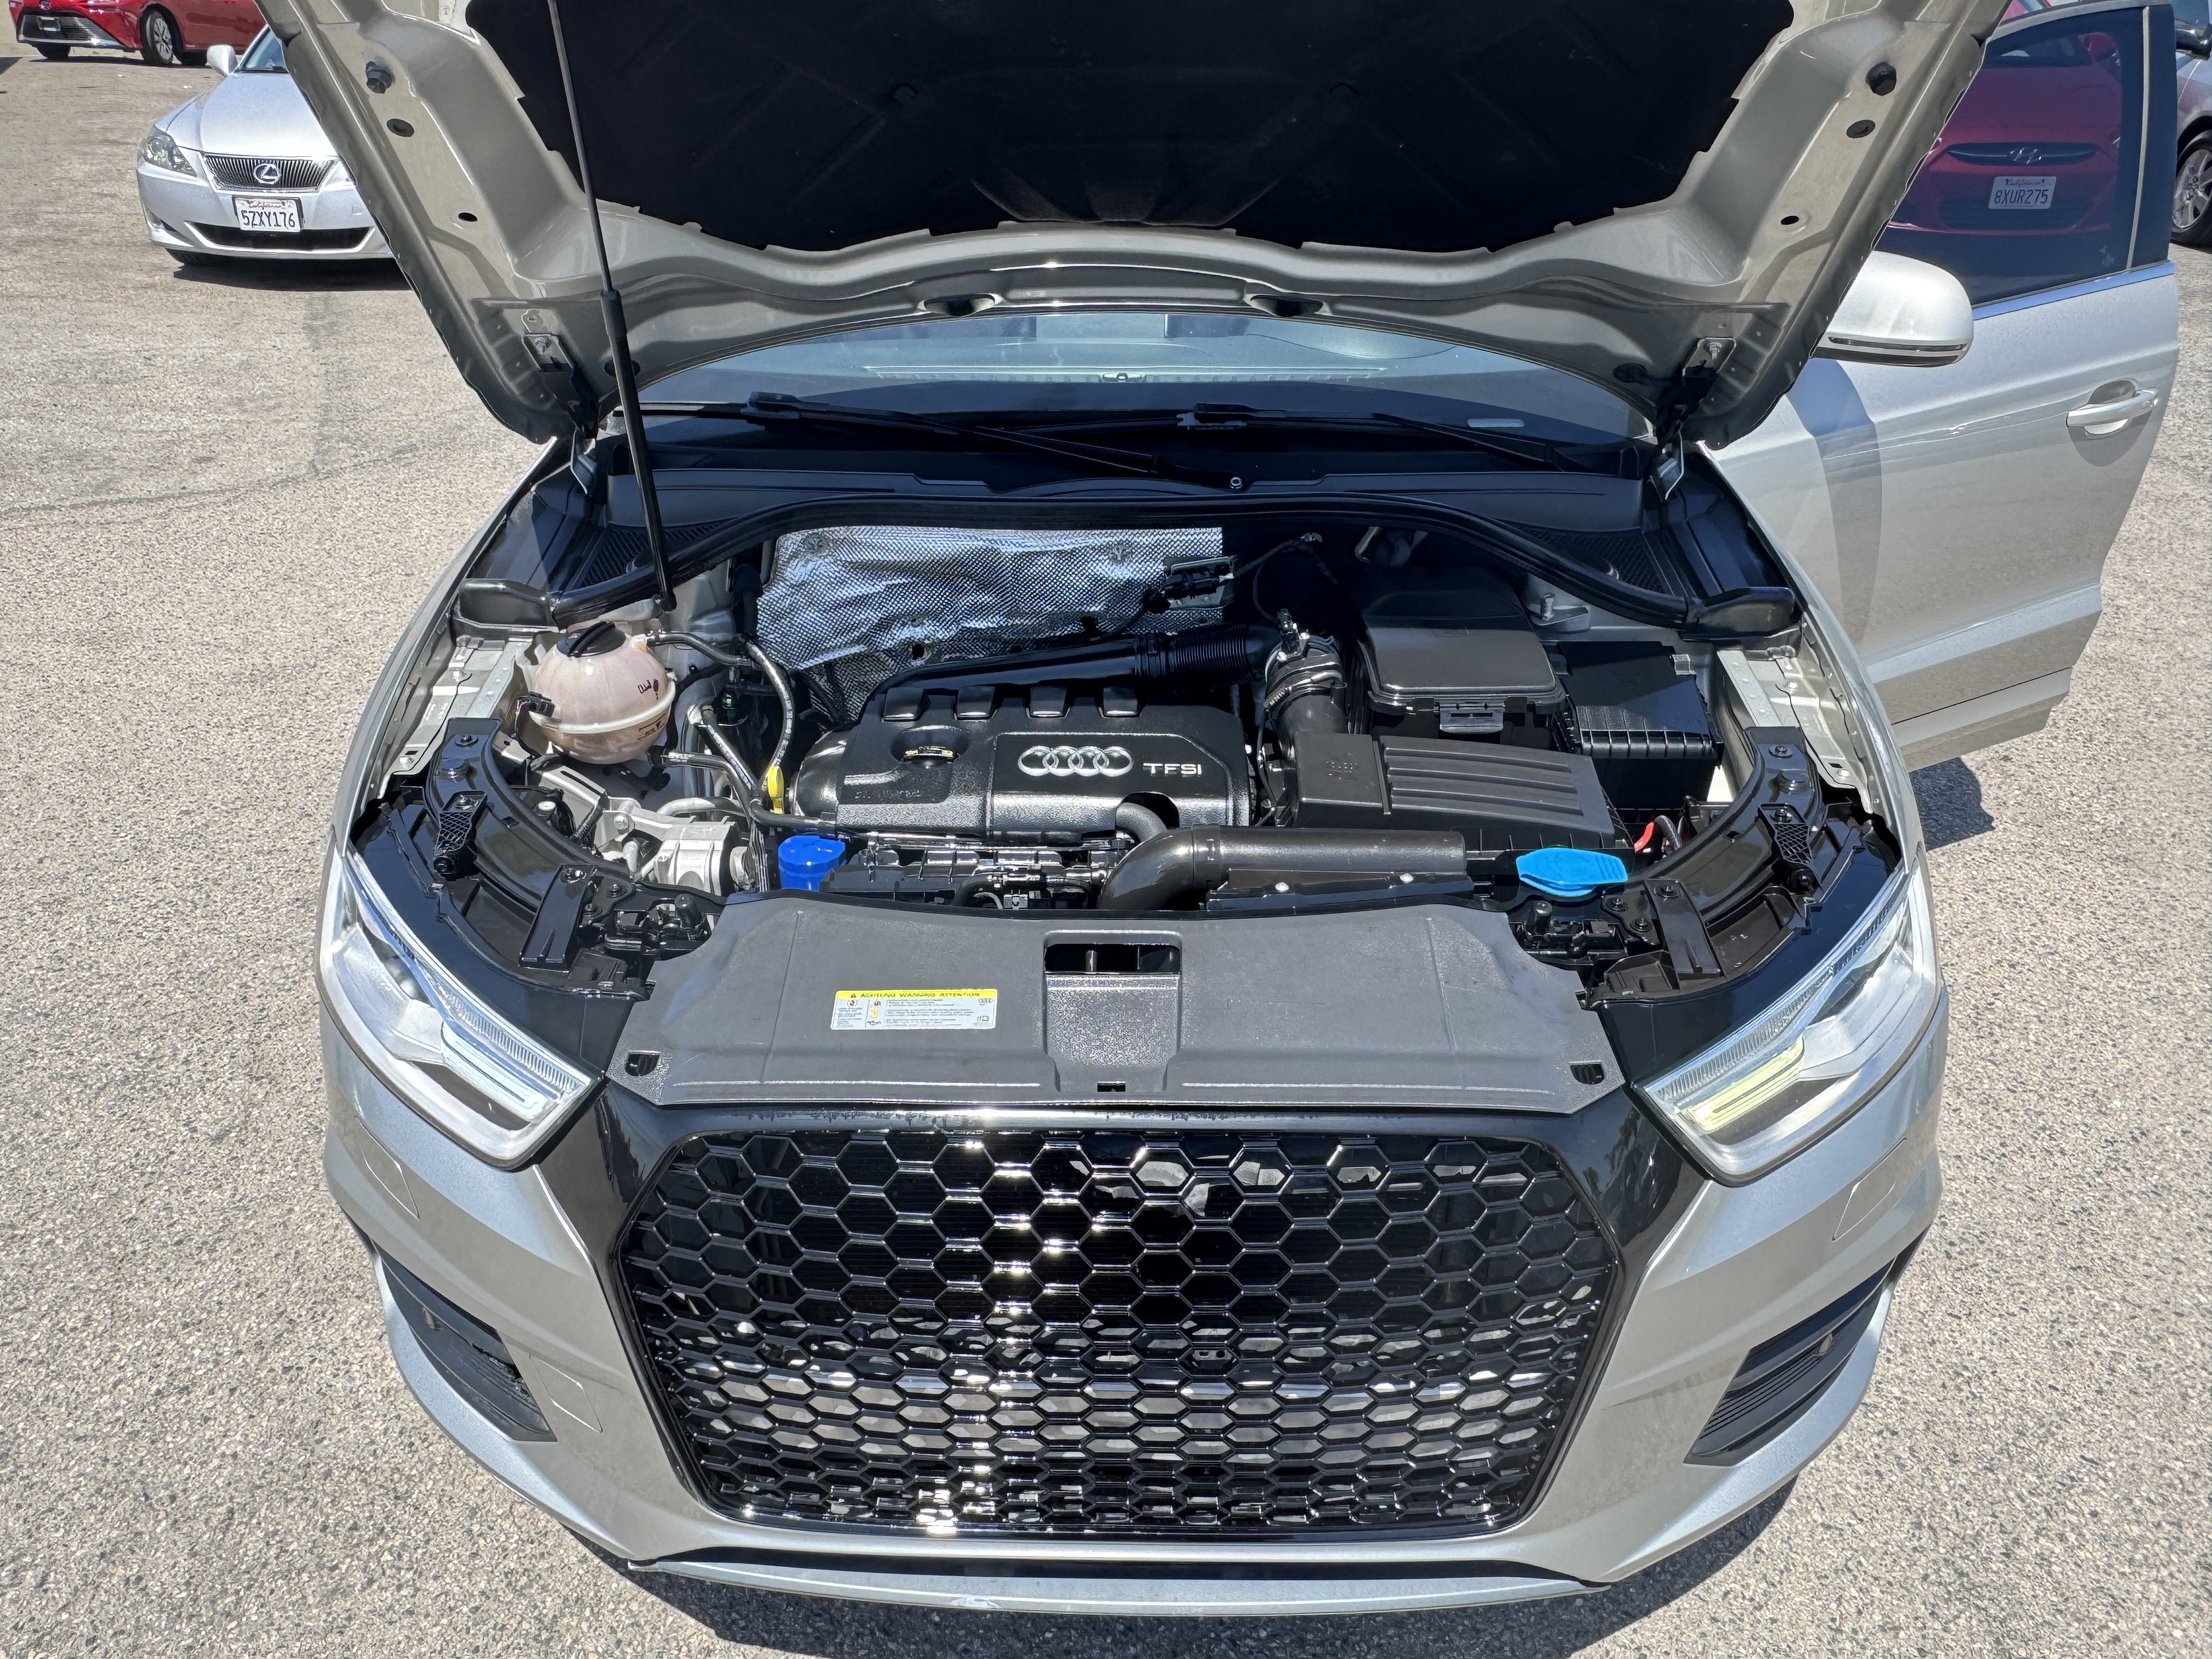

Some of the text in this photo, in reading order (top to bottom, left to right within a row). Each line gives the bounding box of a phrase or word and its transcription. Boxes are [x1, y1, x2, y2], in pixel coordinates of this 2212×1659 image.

[1994, 189, 2049, 205] 8XUR275
[241, 210, 295, 229] 5ZXY176
[1143, 763, 1202, 776] TFSI
